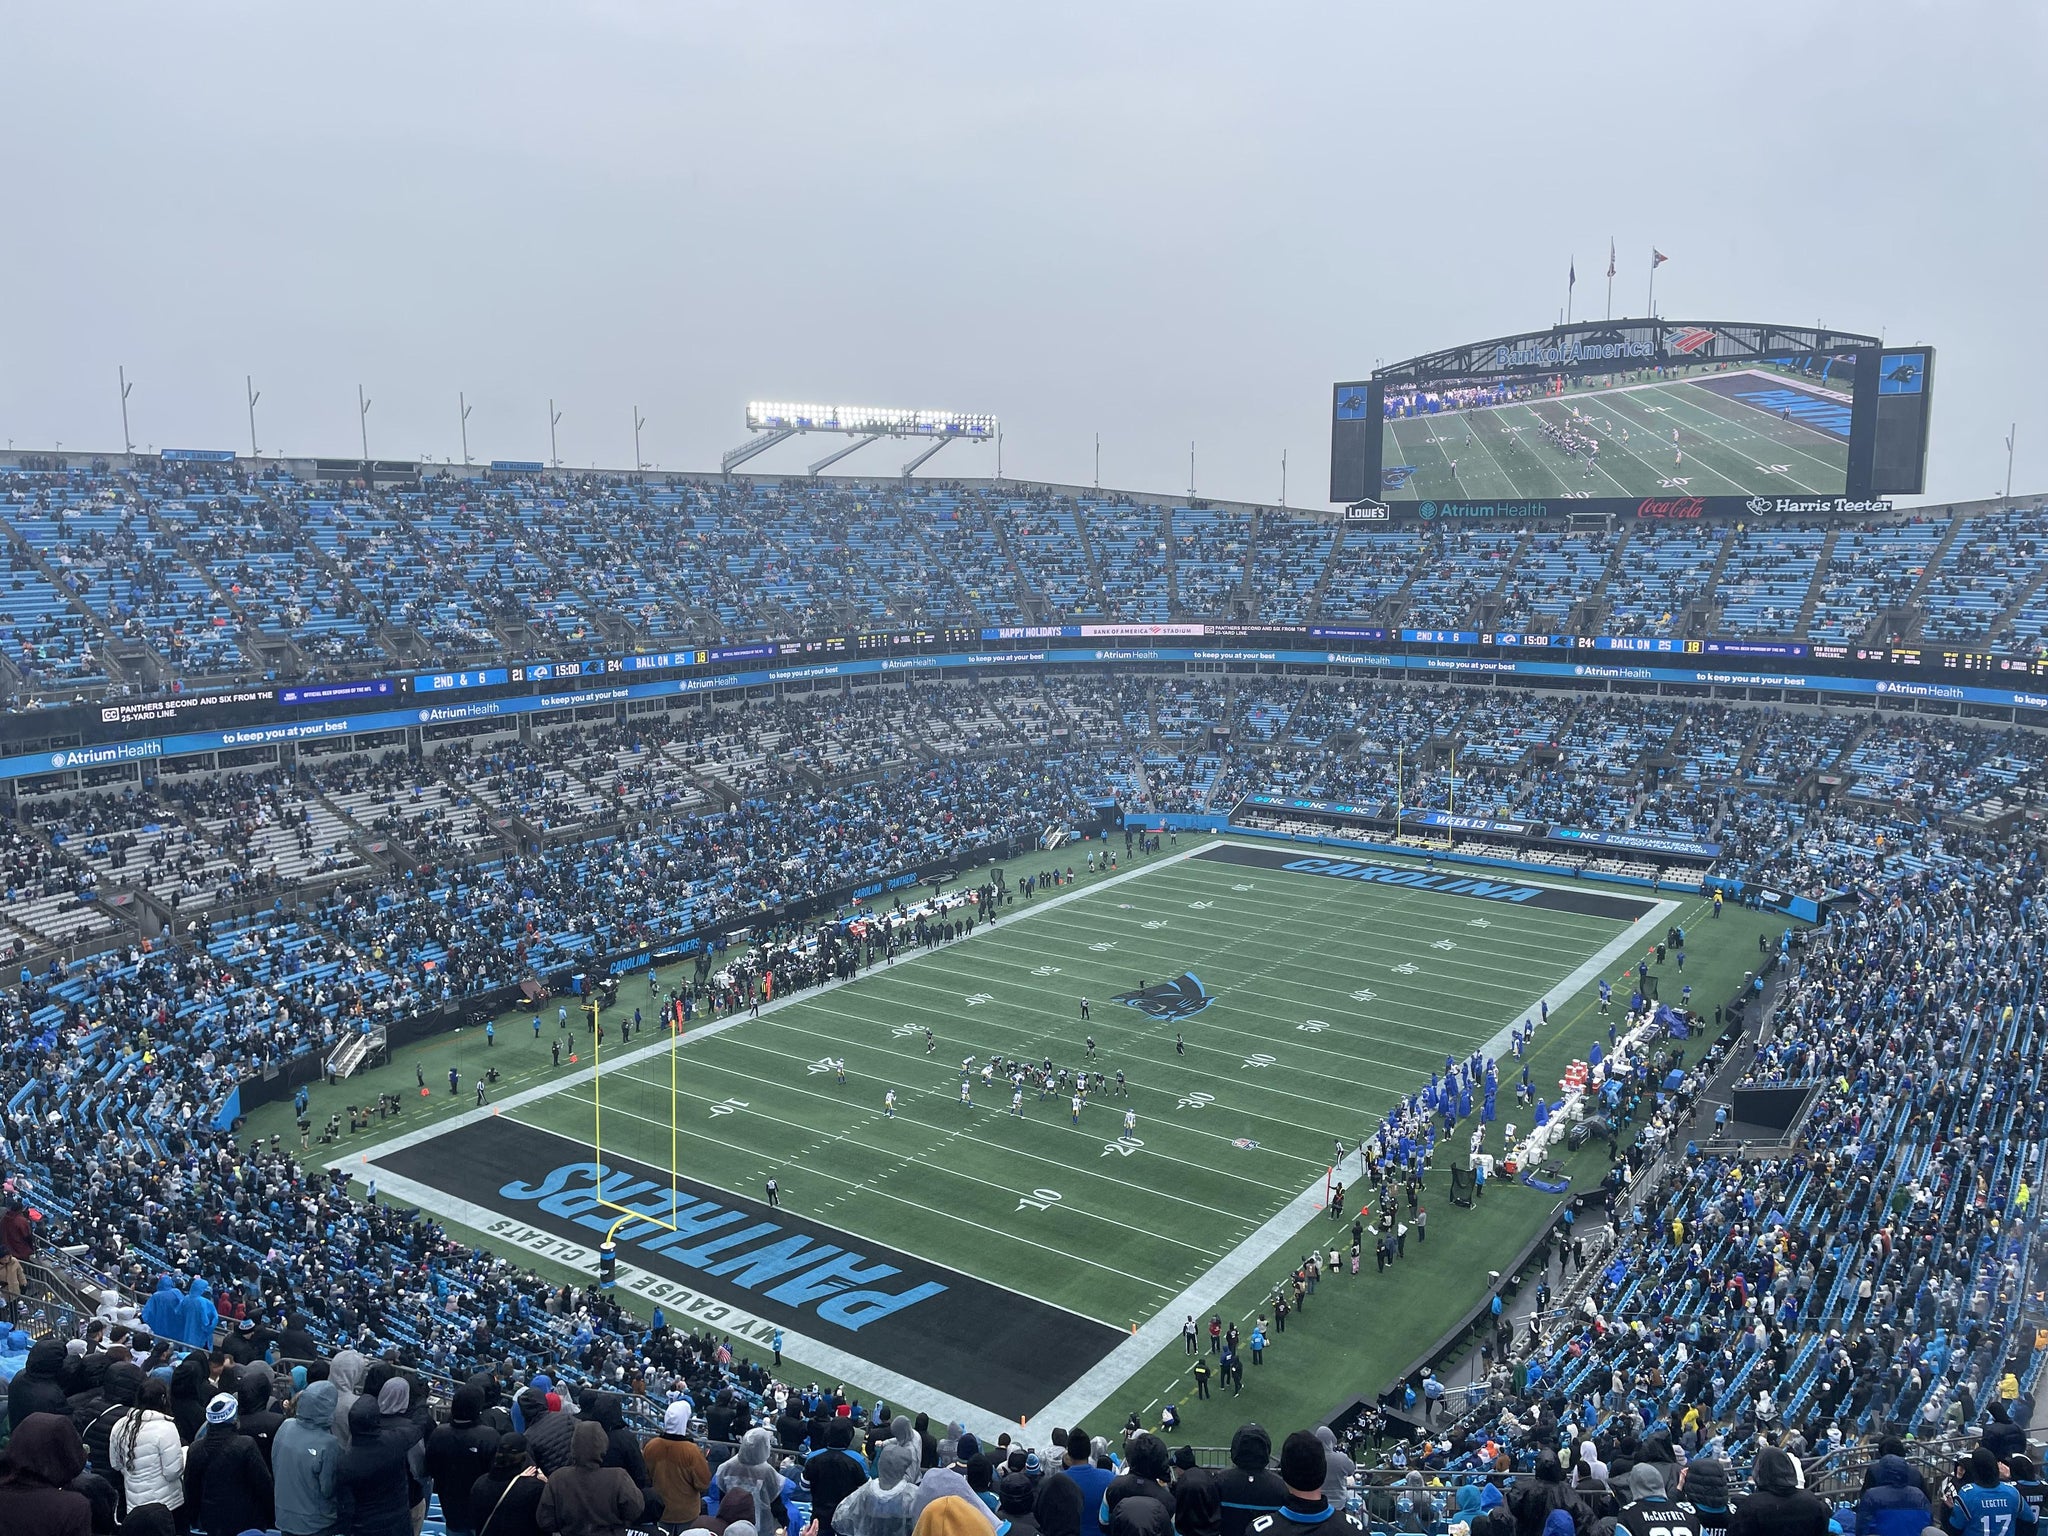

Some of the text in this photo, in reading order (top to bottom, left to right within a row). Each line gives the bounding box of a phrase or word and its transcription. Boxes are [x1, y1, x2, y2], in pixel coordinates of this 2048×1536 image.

[1497, 338, 1654, 366] Bank of America
[1349, 507, 1385, 518] LOWE'S
[1441, 503, 1547, 516] Atrium Health
[1776, 499, 1892, 514] Harris Teeter
[1000, 628, 1024, 638] HAPPY
[1026, 626, 1062, 638] HOLIDAYS
[1416, 632, 1460, 642] 2ND & 6
[1482, 634, 1492, 644] 21
[1523, 636, 1548, 646] 15:00
[1578, 638, 1591, 648] 24
[1611, 638, 1672, 650] BALL ON 25
[1688, 641, 1700, 652] 18
[636, 652, 686, 669] BALL ON 25
[696, 651, 706, 664] 18
[976, 654, 991, 664] keep
[992, 654, 1005, 663] you
[1014, 654, 1027, 662] your
[1028, 652, 1044, 660] best
[1103, 650, 1158, 659] Atrium Health
[1202, 652, 1219, 660] keep
[1260, 652, 1276, 660] best
[1336, 655, 1390, 665] Atrium Health
[607, 659, 620, 672] 24
[888, 657, 936, 668] Atrium Health
[1436, 660, 1454, 668] keep
[1456, 662, 1470, 670] you
[1470, 661, 1479, 669] at
[1480, 662, 1498, 671] your
[1498, 662, 1516, 671] best
[512, 668, 524, 682] 21
[554, 664, 580, 677] 15:00
[776, 670, 790, 680] keep
[790, 670, 803, 678] you
[804, 668, 811, 676] at
[811, 668, 824, 676] your
[824, 666, 838, 674] best
[1584, 666, 1651, 678] Atrium Health
[434, 672, 486, 688] 2ND & 6
[687, 676, 738, 689] Atrium Health
[1696, 672, 1806, 686] to keep you at your best
[1888, 682, 1964, 698] Atrium Health
[120, 702, 164, 714] PANTHERS
[165, 698, 198, 710] SECOND
[200, 696, 218, 706] AND
[219, 695, 232, 704] SIX
[233, 693, 257, 702] FROM
[257, 691, 273, 700] THE
[541, 688, 629, 706] to keep you at your best
[2014, 694, 2047, 707] to keep
[121, 710, 177, 723] 25-YARD LINE.
[430, 703, 500, 720] Atrium Health
[222, 720, 348, 745] to keep you at your best
[66, 742, 162, 766] Atrium Health
[1309, 802, 1327, 810] NC
[1436, 816, 1470, 827] WEEK
[1471, 820, 1488, 829] 13
[1579, 832, 1600, 841] NC
[1281, 858, 1544, 902] CAROLINA
[853, 882, 883, 898] CAROLINA
[609, 951, 651, 975] CAROLINA
[1296, 1019, 1330, 1033] 50
[1245, 1053, 1277, 1069] 40
[1181, 1091, 1216, 1110] 30
[1104, 1136, 1145, 1158] 20
[1020, 1188, 1062, 1212] 10
[487, 1220, 586, 1262] CLEATS
[499, 1162, 949, 1333] PANTHERS
[631, 1275, 731, 1321] CAUSE
[1982, 1499, 2008, 1508] LEGETTE
[1642, 1510, 1687, 1522] McCAFFREY
[1981, 1514, 2012, 1536] 17
